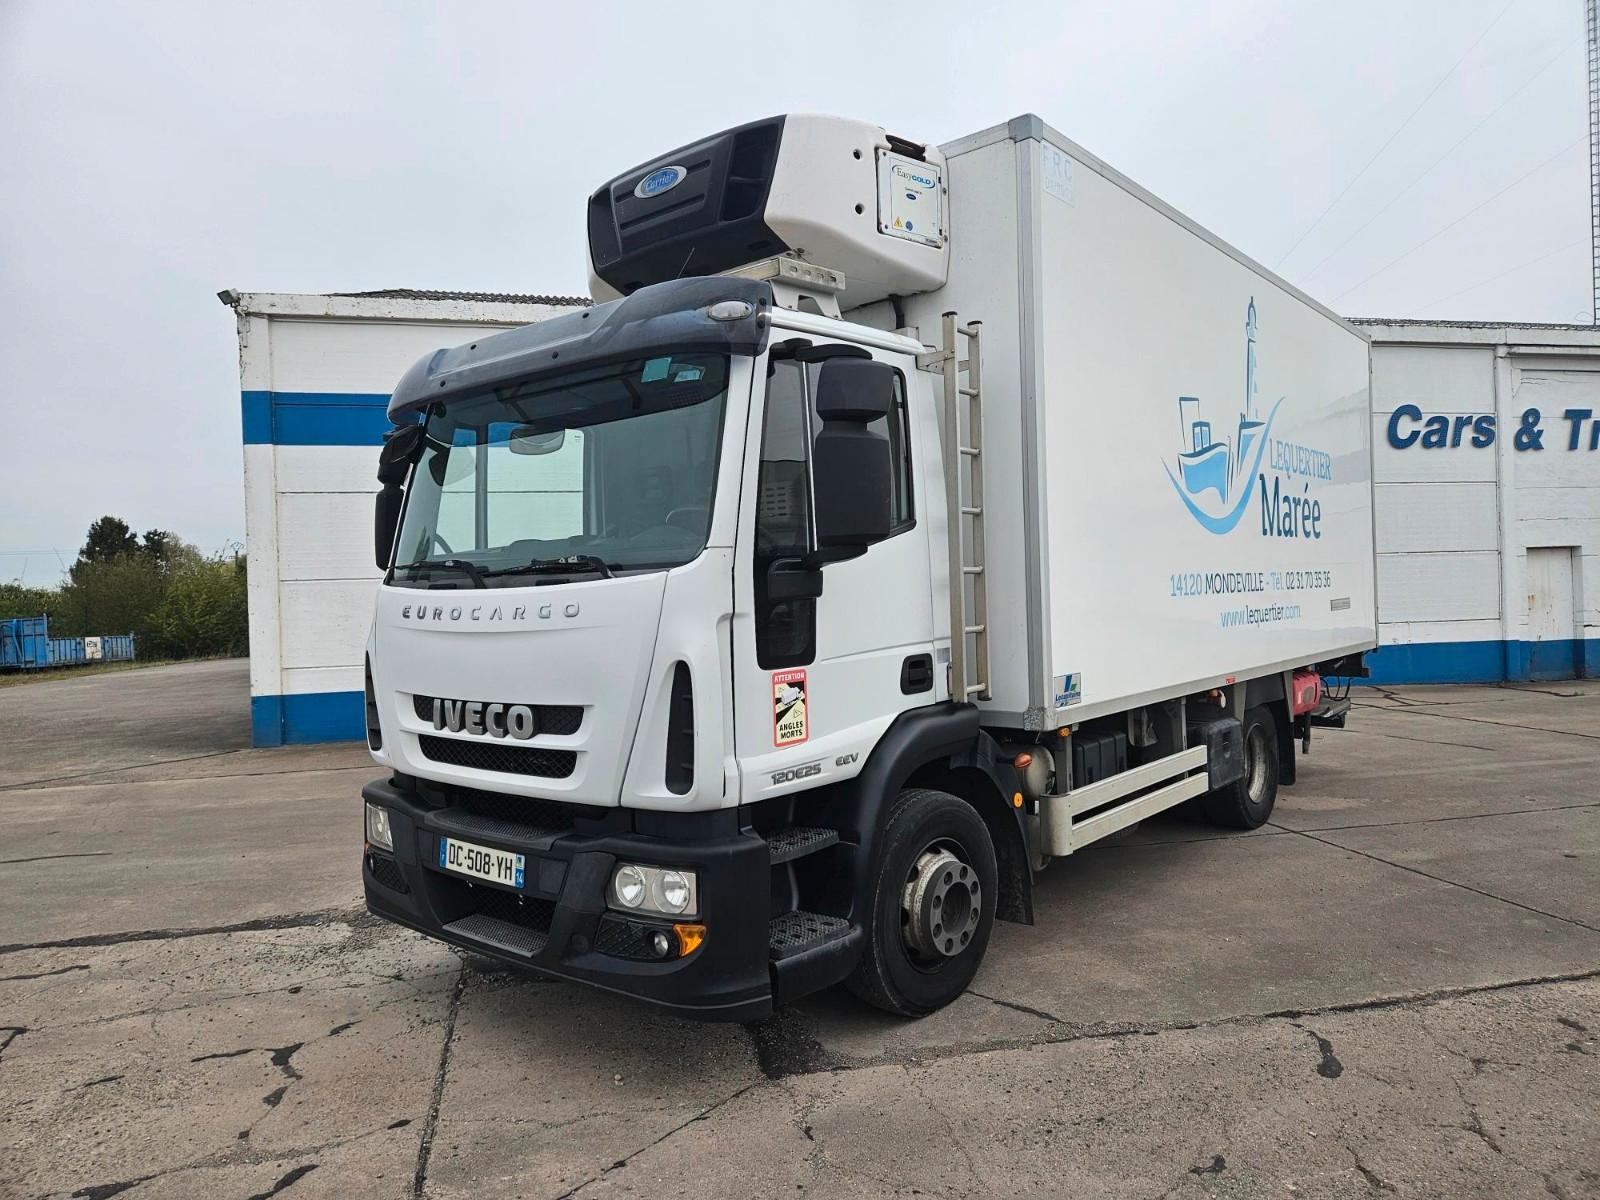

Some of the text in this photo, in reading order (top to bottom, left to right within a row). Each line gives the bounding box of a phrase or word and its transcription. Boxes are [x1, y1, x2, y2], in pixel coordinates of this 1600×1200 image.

[645, 172, 674, 193] Carrier
[1387, 404, 1496, 450] Cars
[1514, 407, 1545, 451] &
[1269, 438, 1332, 481] LEQUERTIER
[1259, 473, 1321, 539] Marée
[1170, 573, 1202, 597] 14120
[1205, 572, 1264, 594] MONDEVILLE
[402, 602, 580, 621] EUROCARGO
[1220, 603, 1301, 628] www.lequertier.com
[774, 672, 805, 682] ATTENTION
[432, 698, 534, 739] IVECO
[779, 720, 804, 732] ANGLES
[780, 729, 803, 740] MORTS
[771, 752, 859, 785] 120E25 EEV
